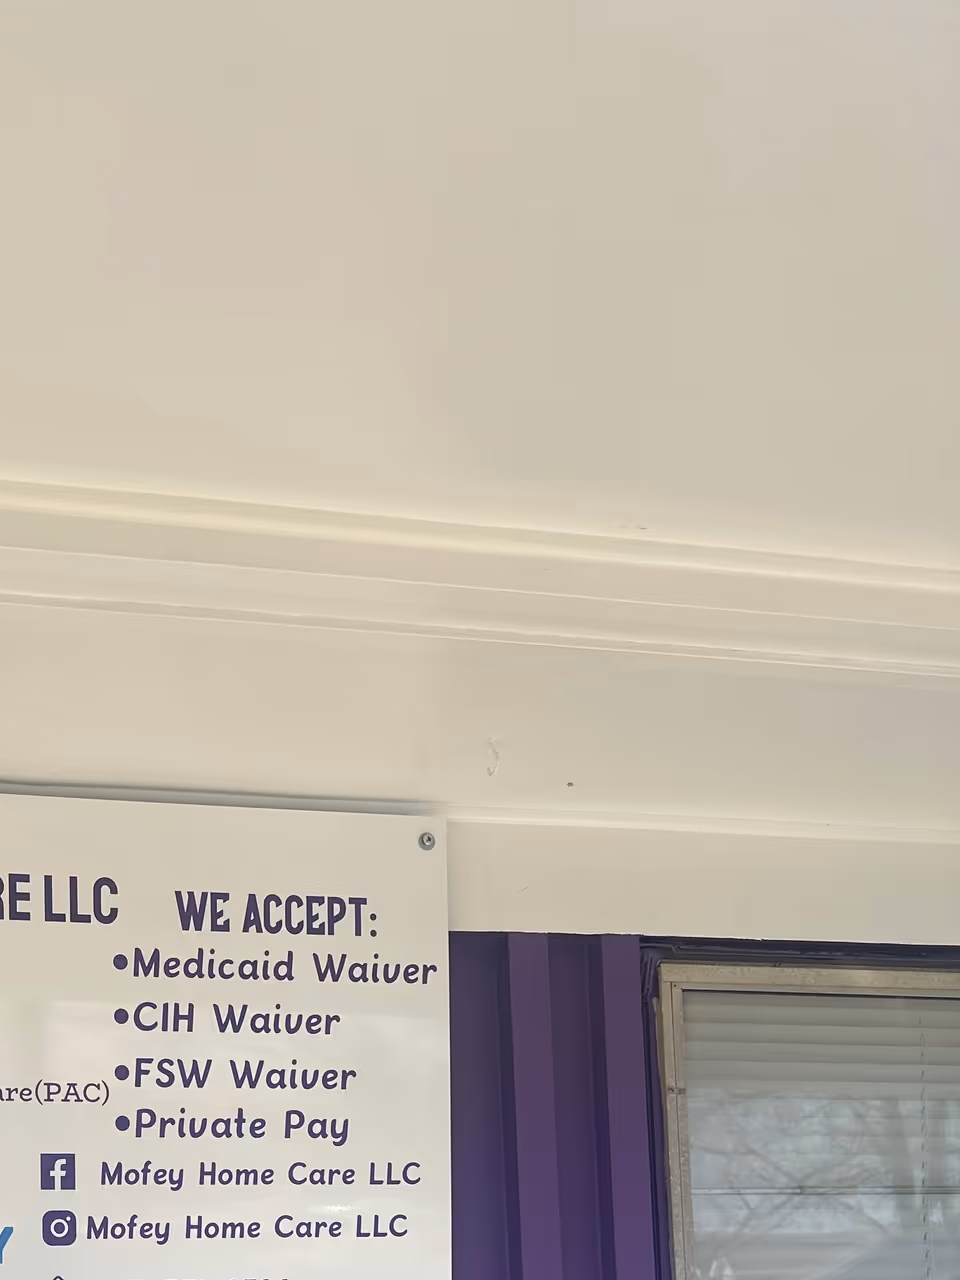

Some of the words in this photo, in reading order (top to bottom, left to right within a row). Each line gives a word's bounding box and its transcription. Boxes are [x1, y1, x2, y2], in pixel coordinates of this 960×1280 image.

[43, 873, 119, 925] LLC
[174, 889, 231, 933] WE
[241, 893, 379, 938] ACCEPT:
[132, 947, 295, 981] Medicaid
[312, 952, 438, 985] Waiver
[133, 1001, 195, 1033] CIH
[212, 1003, 341, 1035] Waiver
[134, 1057, 213, 1089] FSW
[230, 1059, 357, 1091] Waiver
[135, 1107, 267, 1139] Private
[284, 1109, 350, 1147] Pay
[100, 1161, 185, 1191] Mofey
[198, 1161, 275, 1186] Home
[287, 1161, 356, 1186] Care
[369, 1161, 422, 1186] LLC
[86, 1213, 171, 1245] Mofey
[185, 1215, 261, 1239] Home
[274, 1214, 342, 1239] Care
[355, 1214, 409, 1238] LLC
